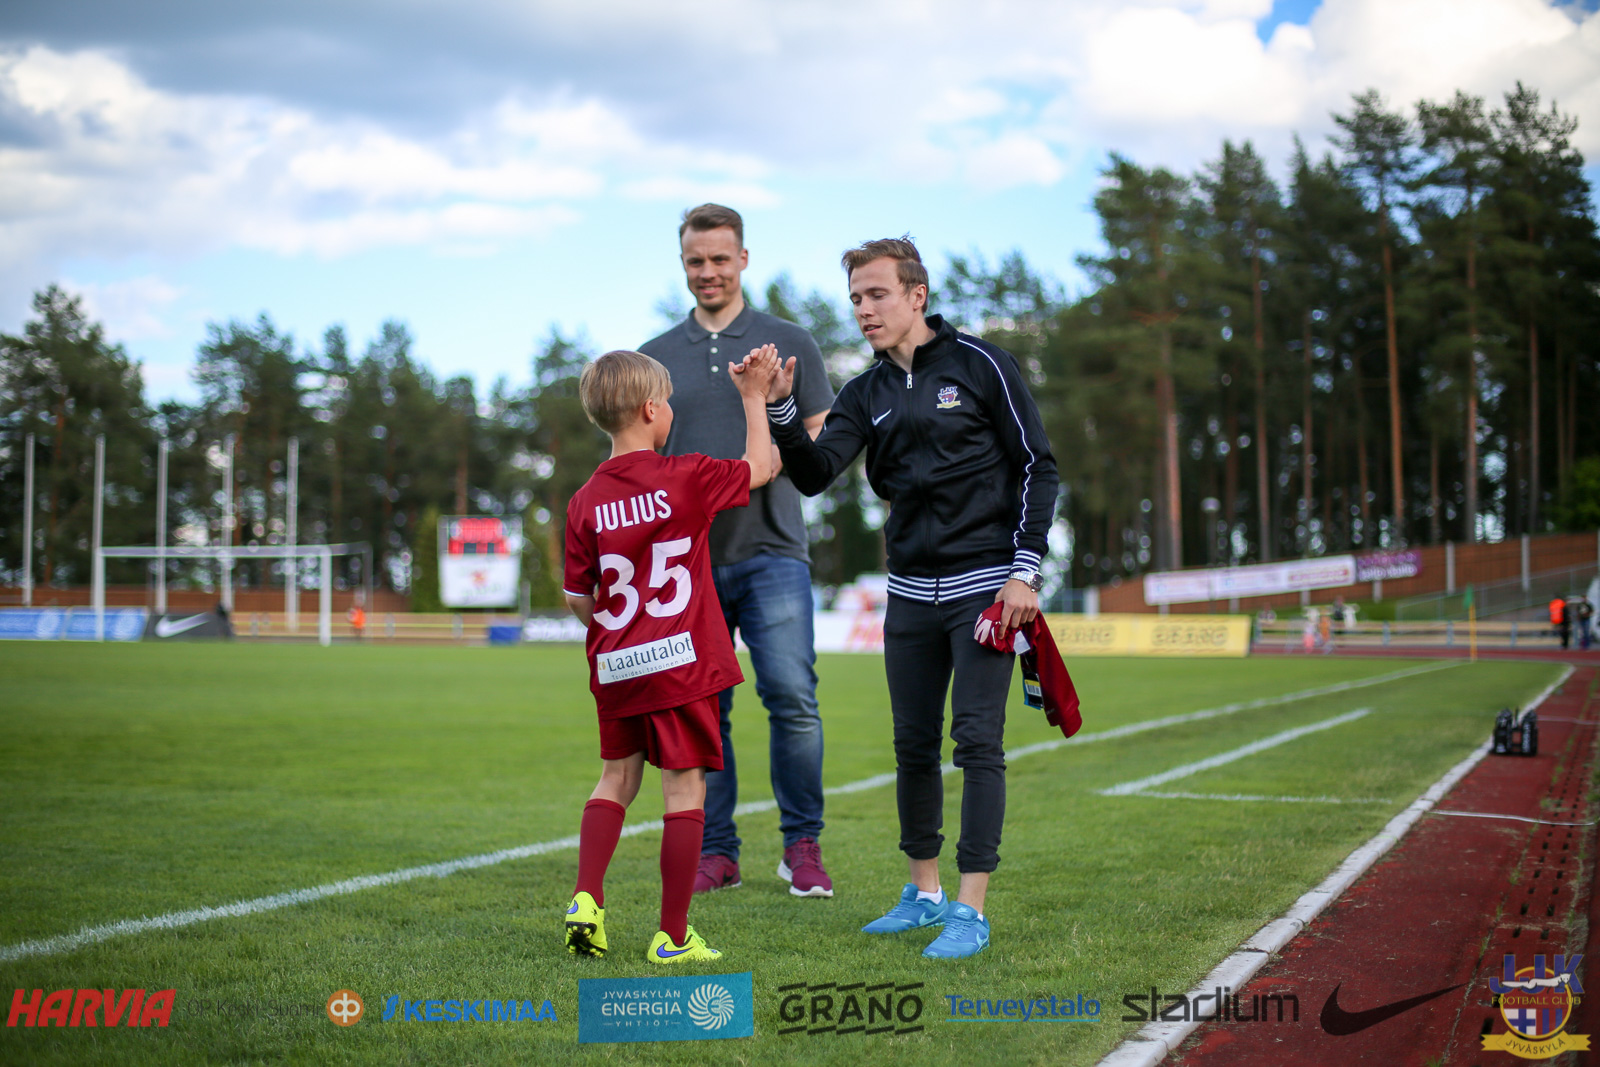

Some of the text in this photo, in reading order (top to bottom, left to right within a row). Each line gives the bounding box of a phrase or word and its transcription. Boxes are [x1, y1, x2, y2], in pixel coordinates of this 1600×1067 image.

[595, 489, 672, 534] JULIUS
[593, 536, 693, 631] 35
[607, 637, 692, 672] Laatutalot
